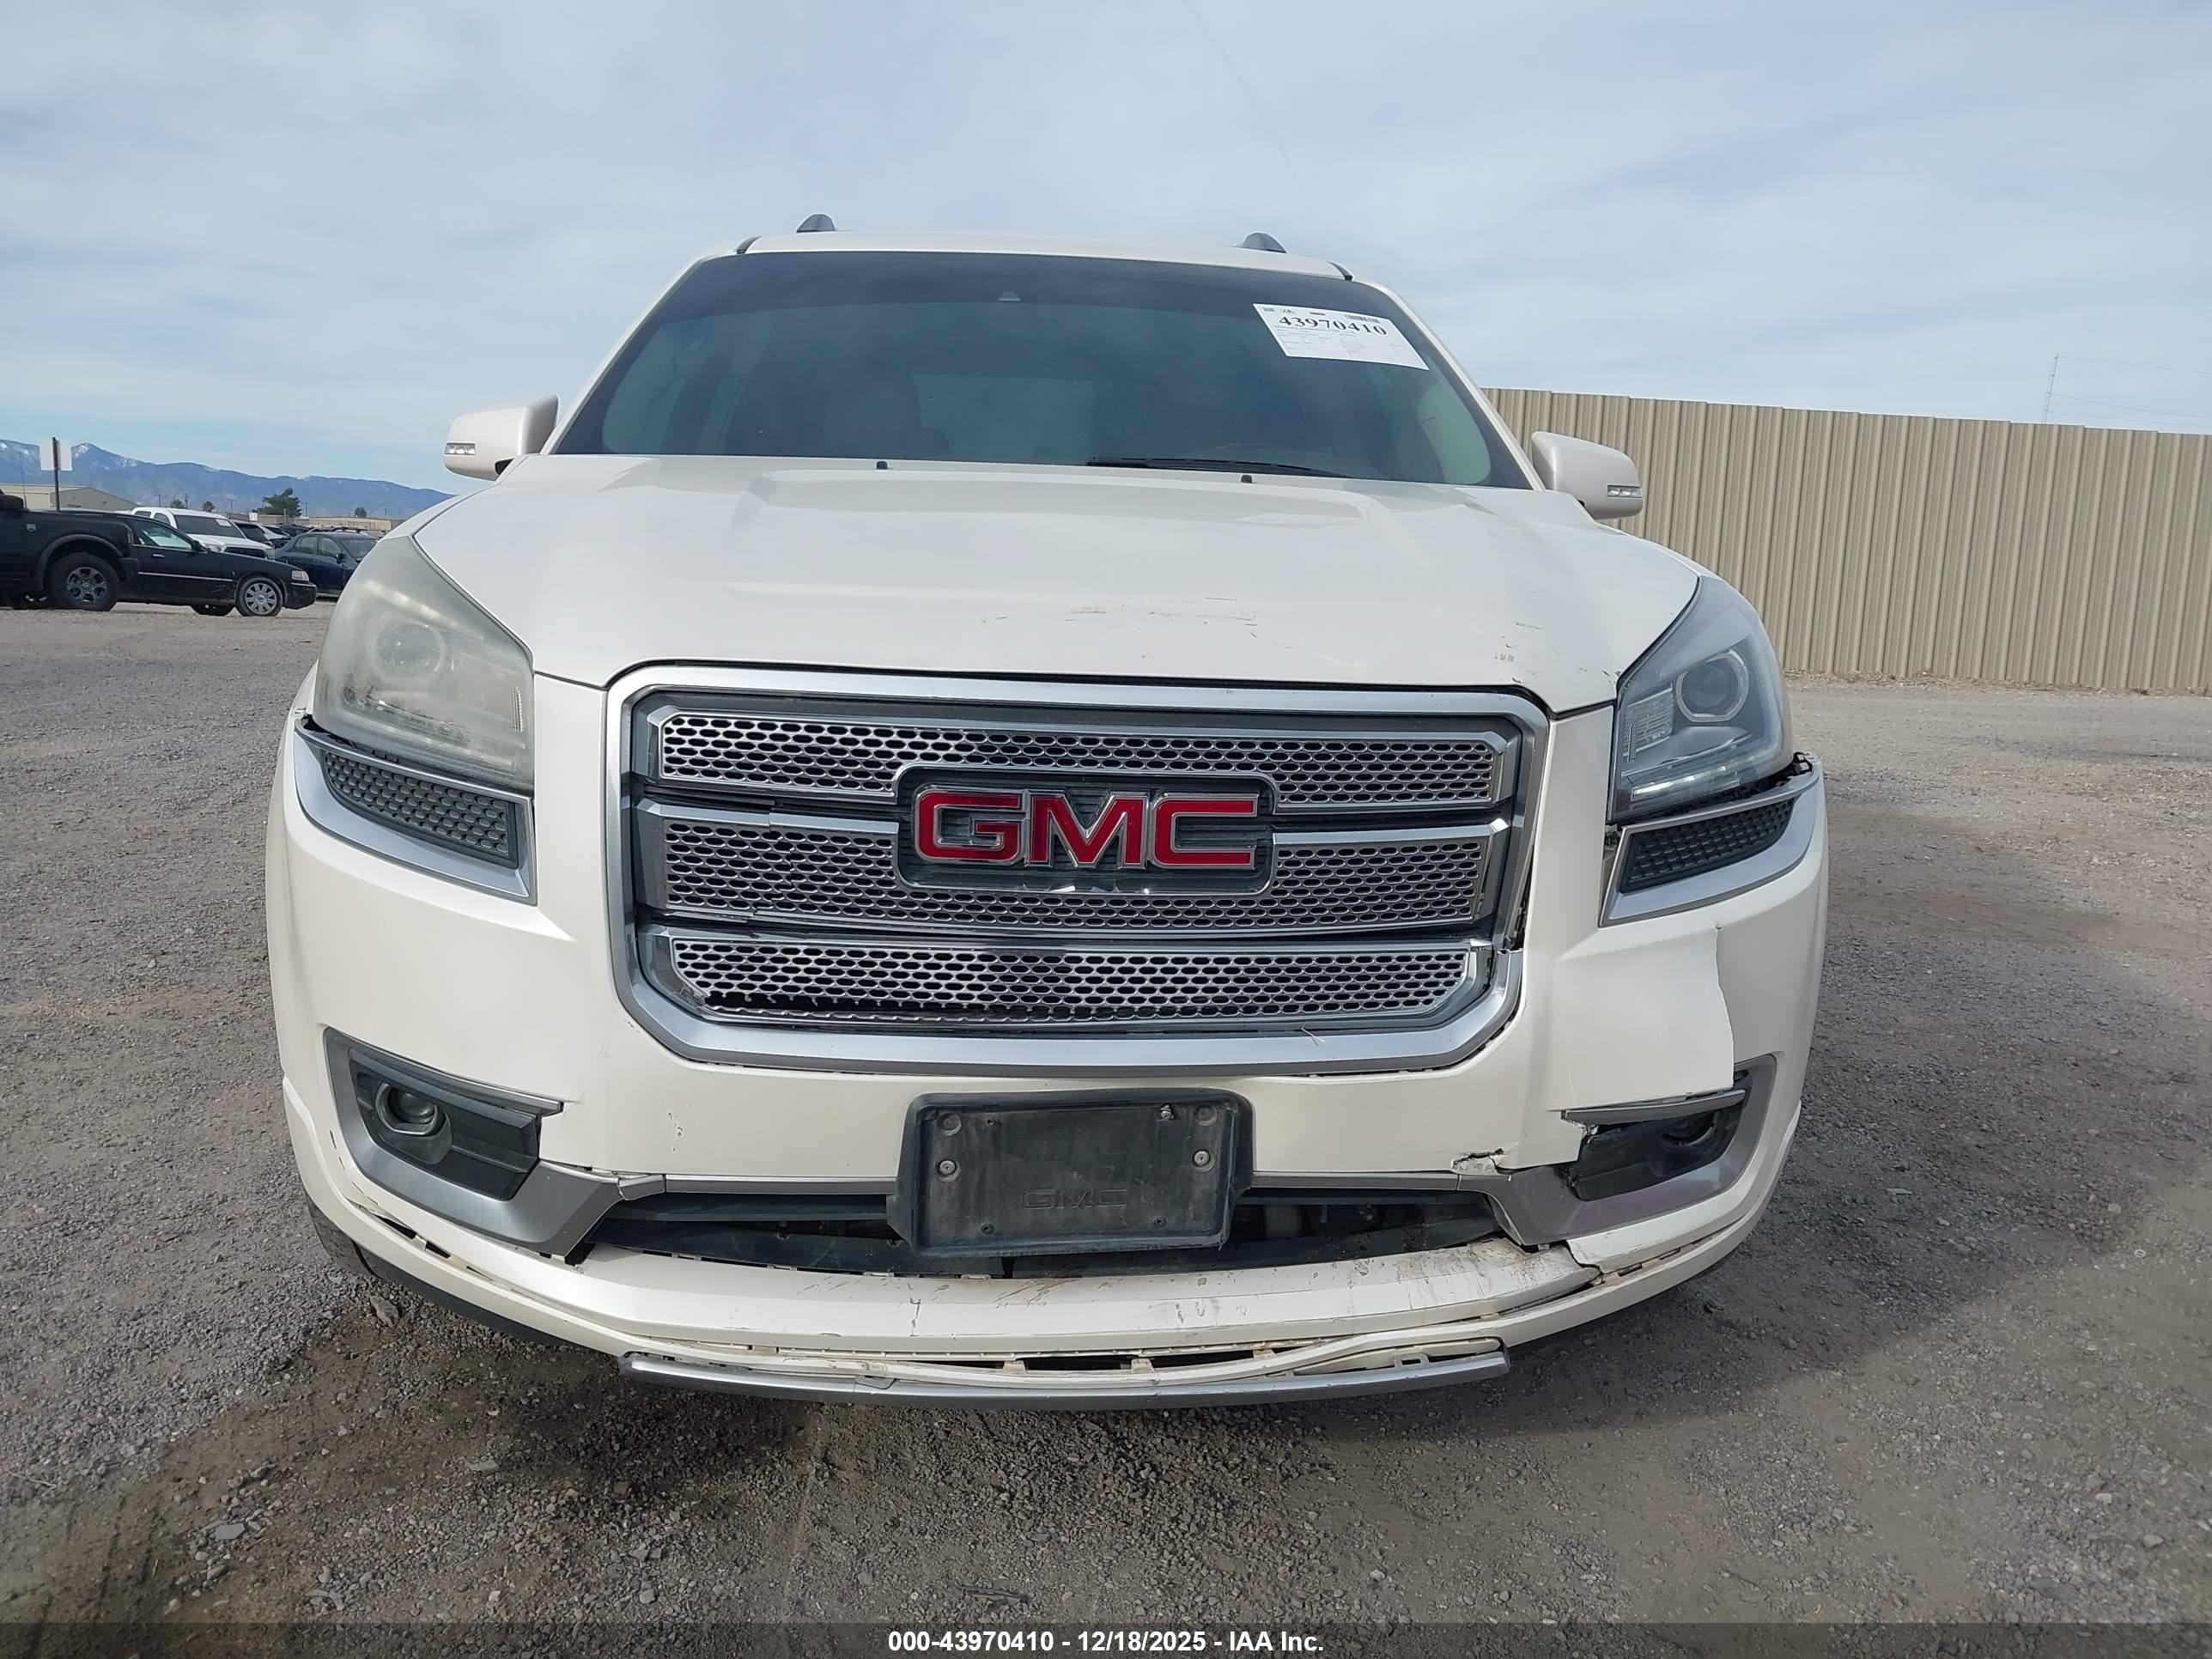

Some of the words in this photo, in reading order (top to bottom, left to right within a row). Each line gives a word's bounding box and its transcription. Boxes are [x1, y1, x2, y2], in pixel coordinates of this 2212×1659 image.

[1279, 316, 1388, 336] 43970410
[915, 784, 1260, 871] GMC
[1023, 1188, 1127, 1210] GMC
